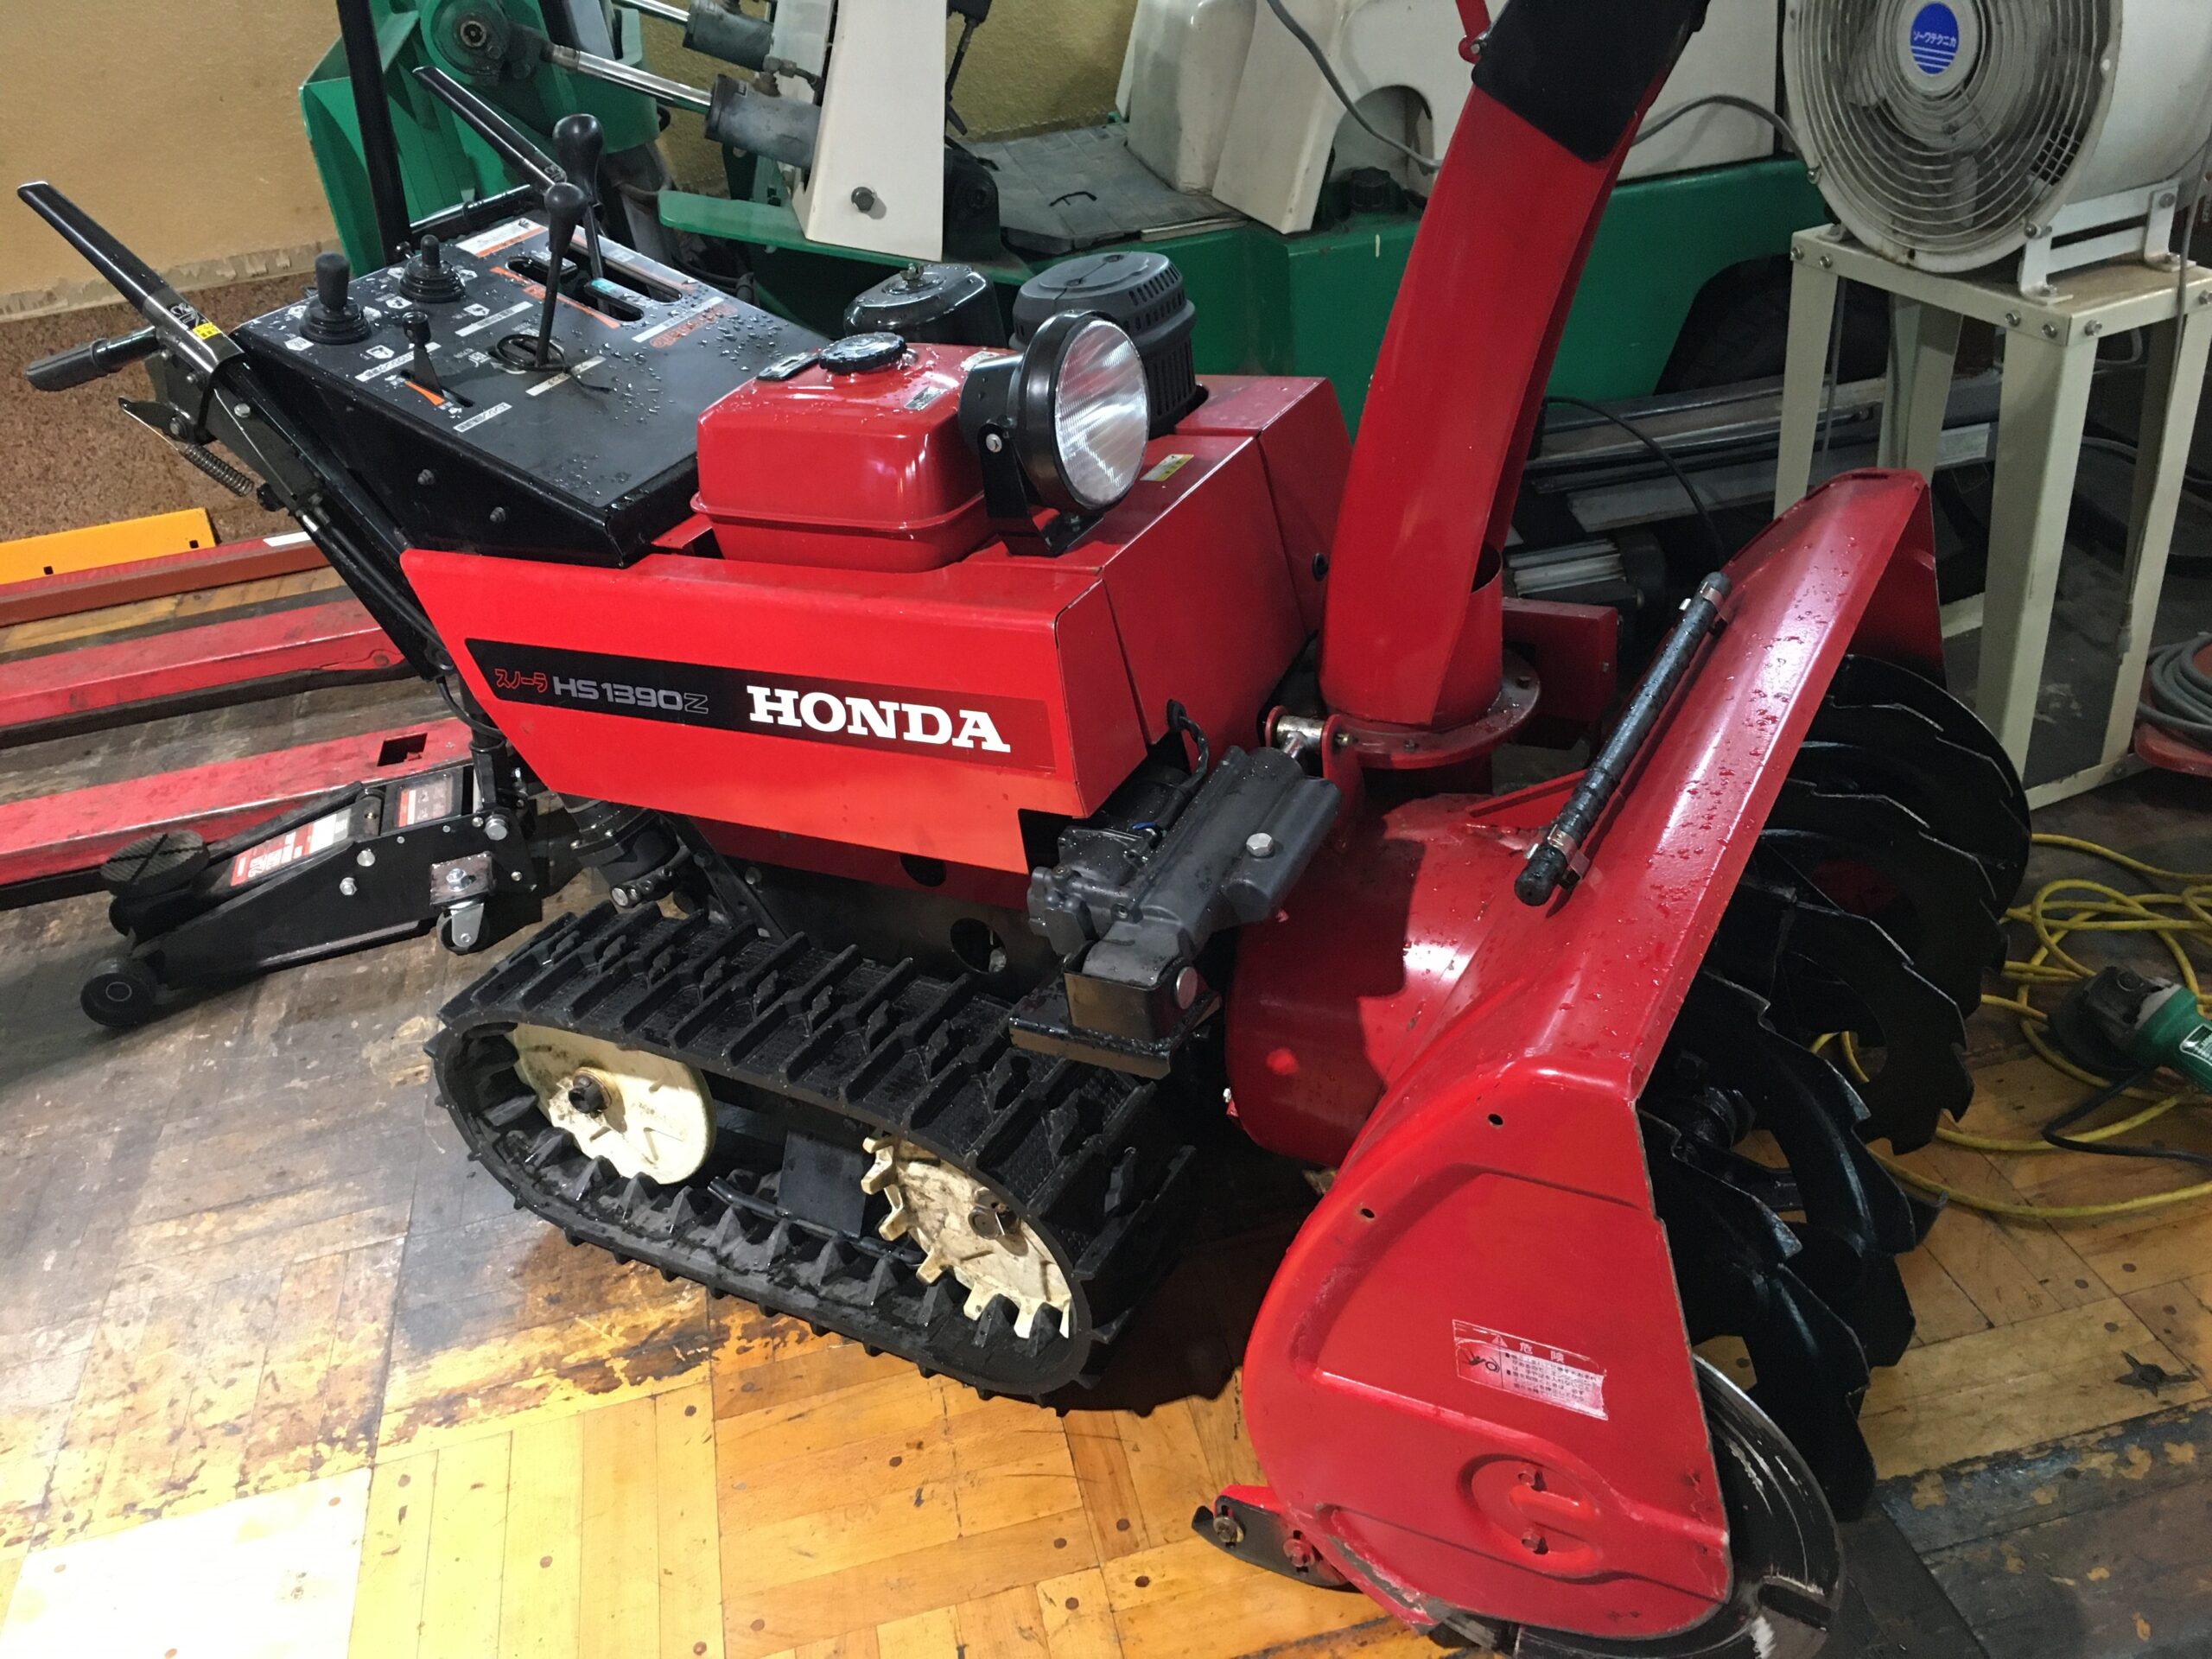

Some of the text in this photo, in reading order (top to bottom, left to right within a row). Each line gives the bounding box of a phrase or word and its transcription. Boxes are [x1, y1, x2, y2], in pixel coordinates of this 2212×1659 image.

[1913, 31, 1956, 48] ソーワテクニカ
[494, 668, 549, 693] スノーラ
[747, 685, 1011, 753] HONDA
